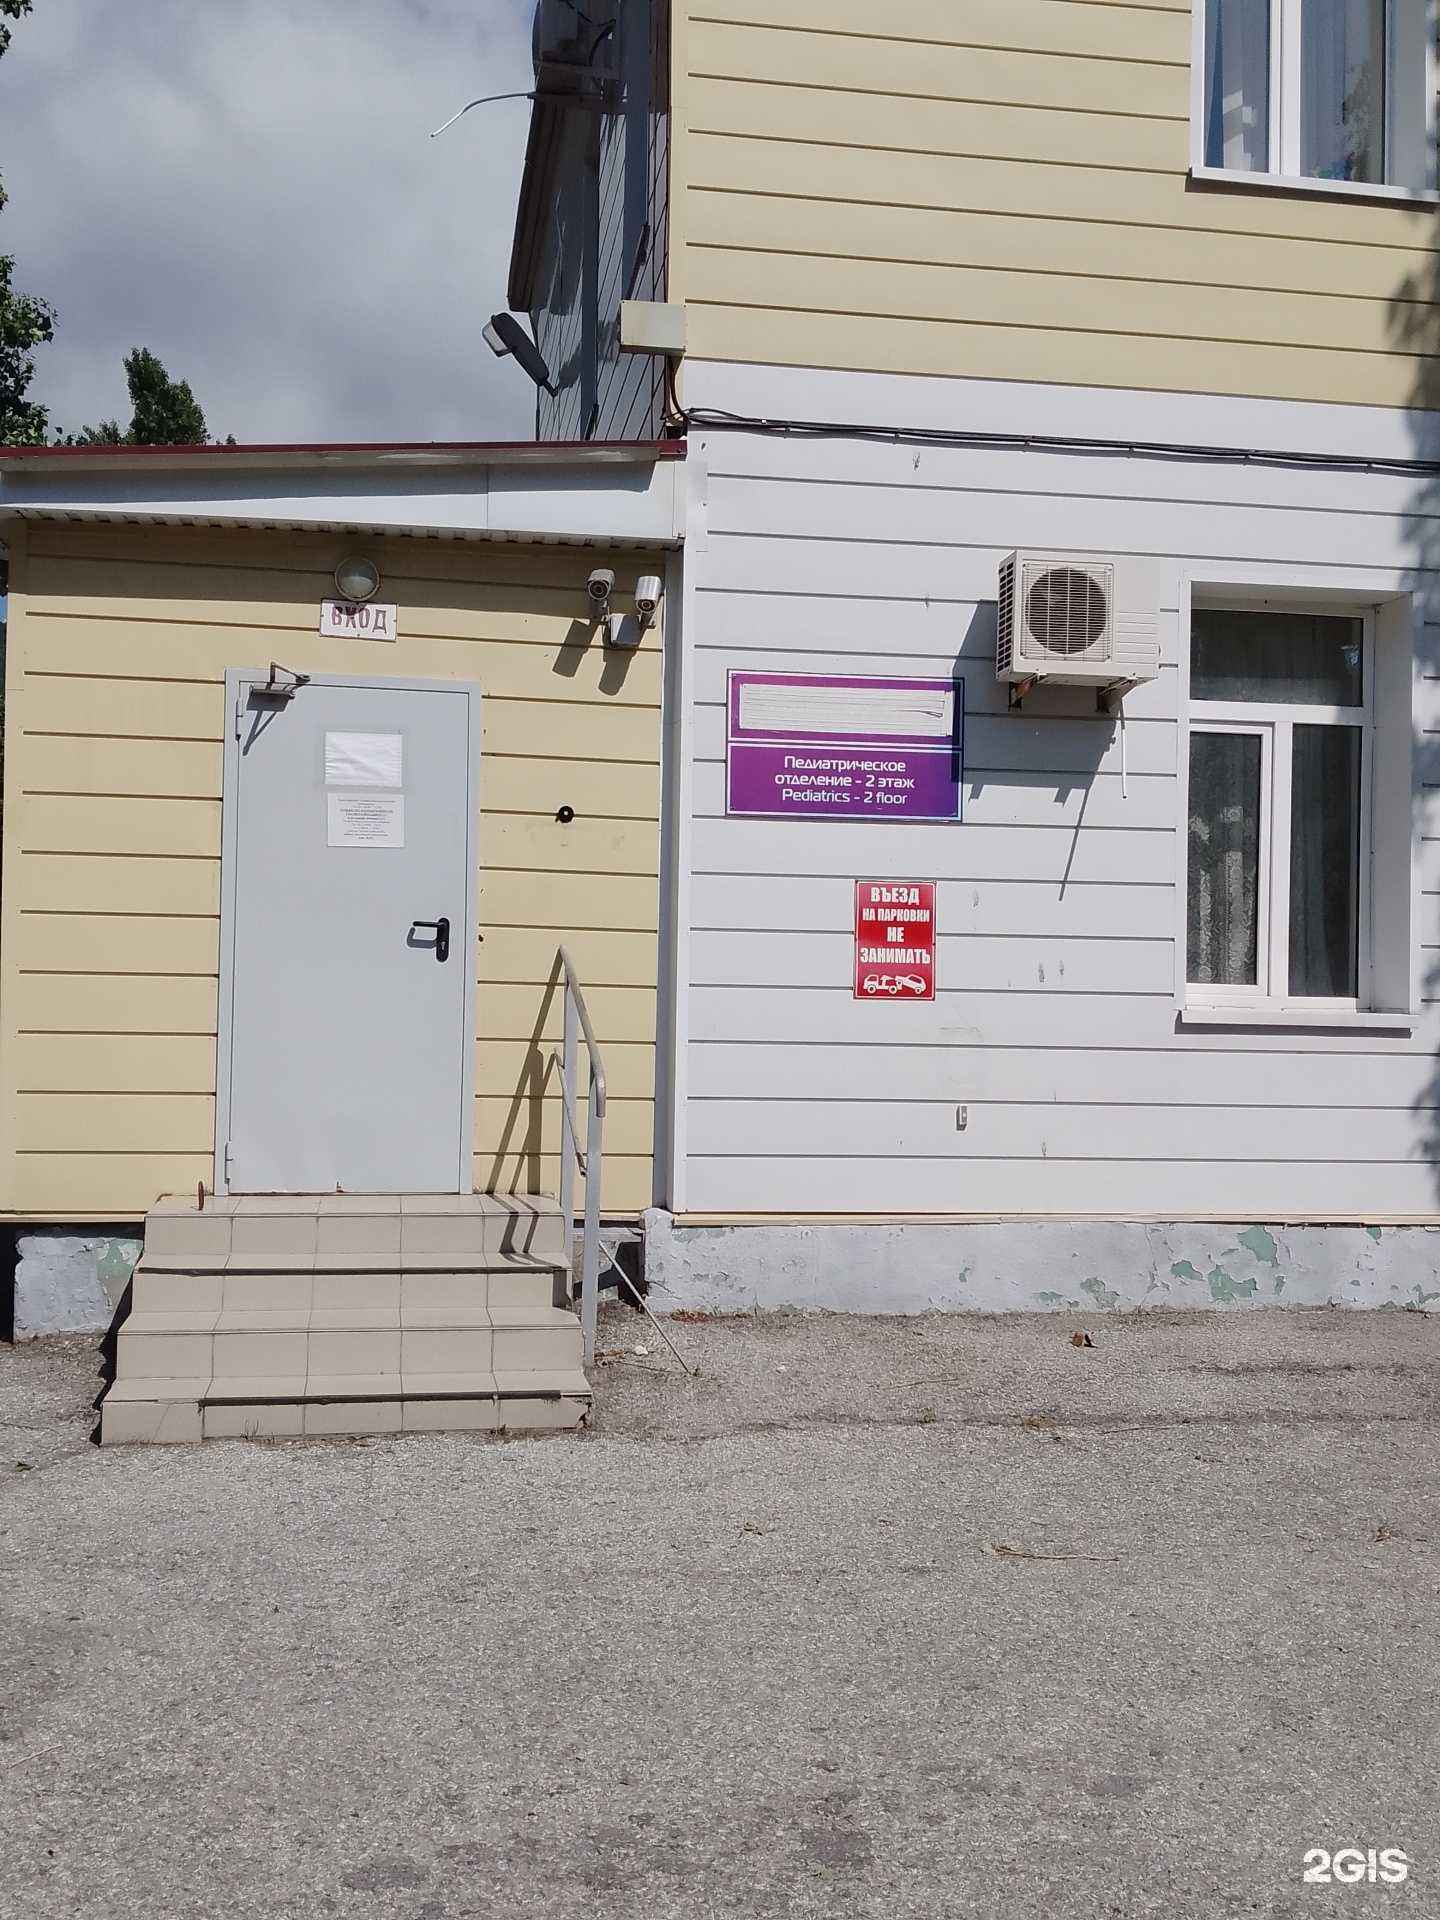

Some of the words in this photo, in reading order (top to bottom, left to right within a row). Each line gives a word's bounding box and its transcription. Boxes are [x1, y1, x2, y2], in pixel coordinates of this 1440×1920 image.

[331, 606, 387, 634] ВХОД
[784, 755, 907, 772] Педиатрическое
[774, 773, 852, 788] отделение
[865, 774, 875, 788] 2
[877, 777, 915, 788] этаж
[782, 788, 851, 803] Pediatrics
[863, 791, 873, 803] 2
[876, 790, 908, 805] floor
[870, 886, 920, 906] ВЪЕЗД
[862, 908, 876, 921] НА
[877, 908, 930, 922] ПАРКОВКИ
[887, 926, 905, 942] НЕ
[860, 947, 931, 965] ЗАНИМАТЬ
